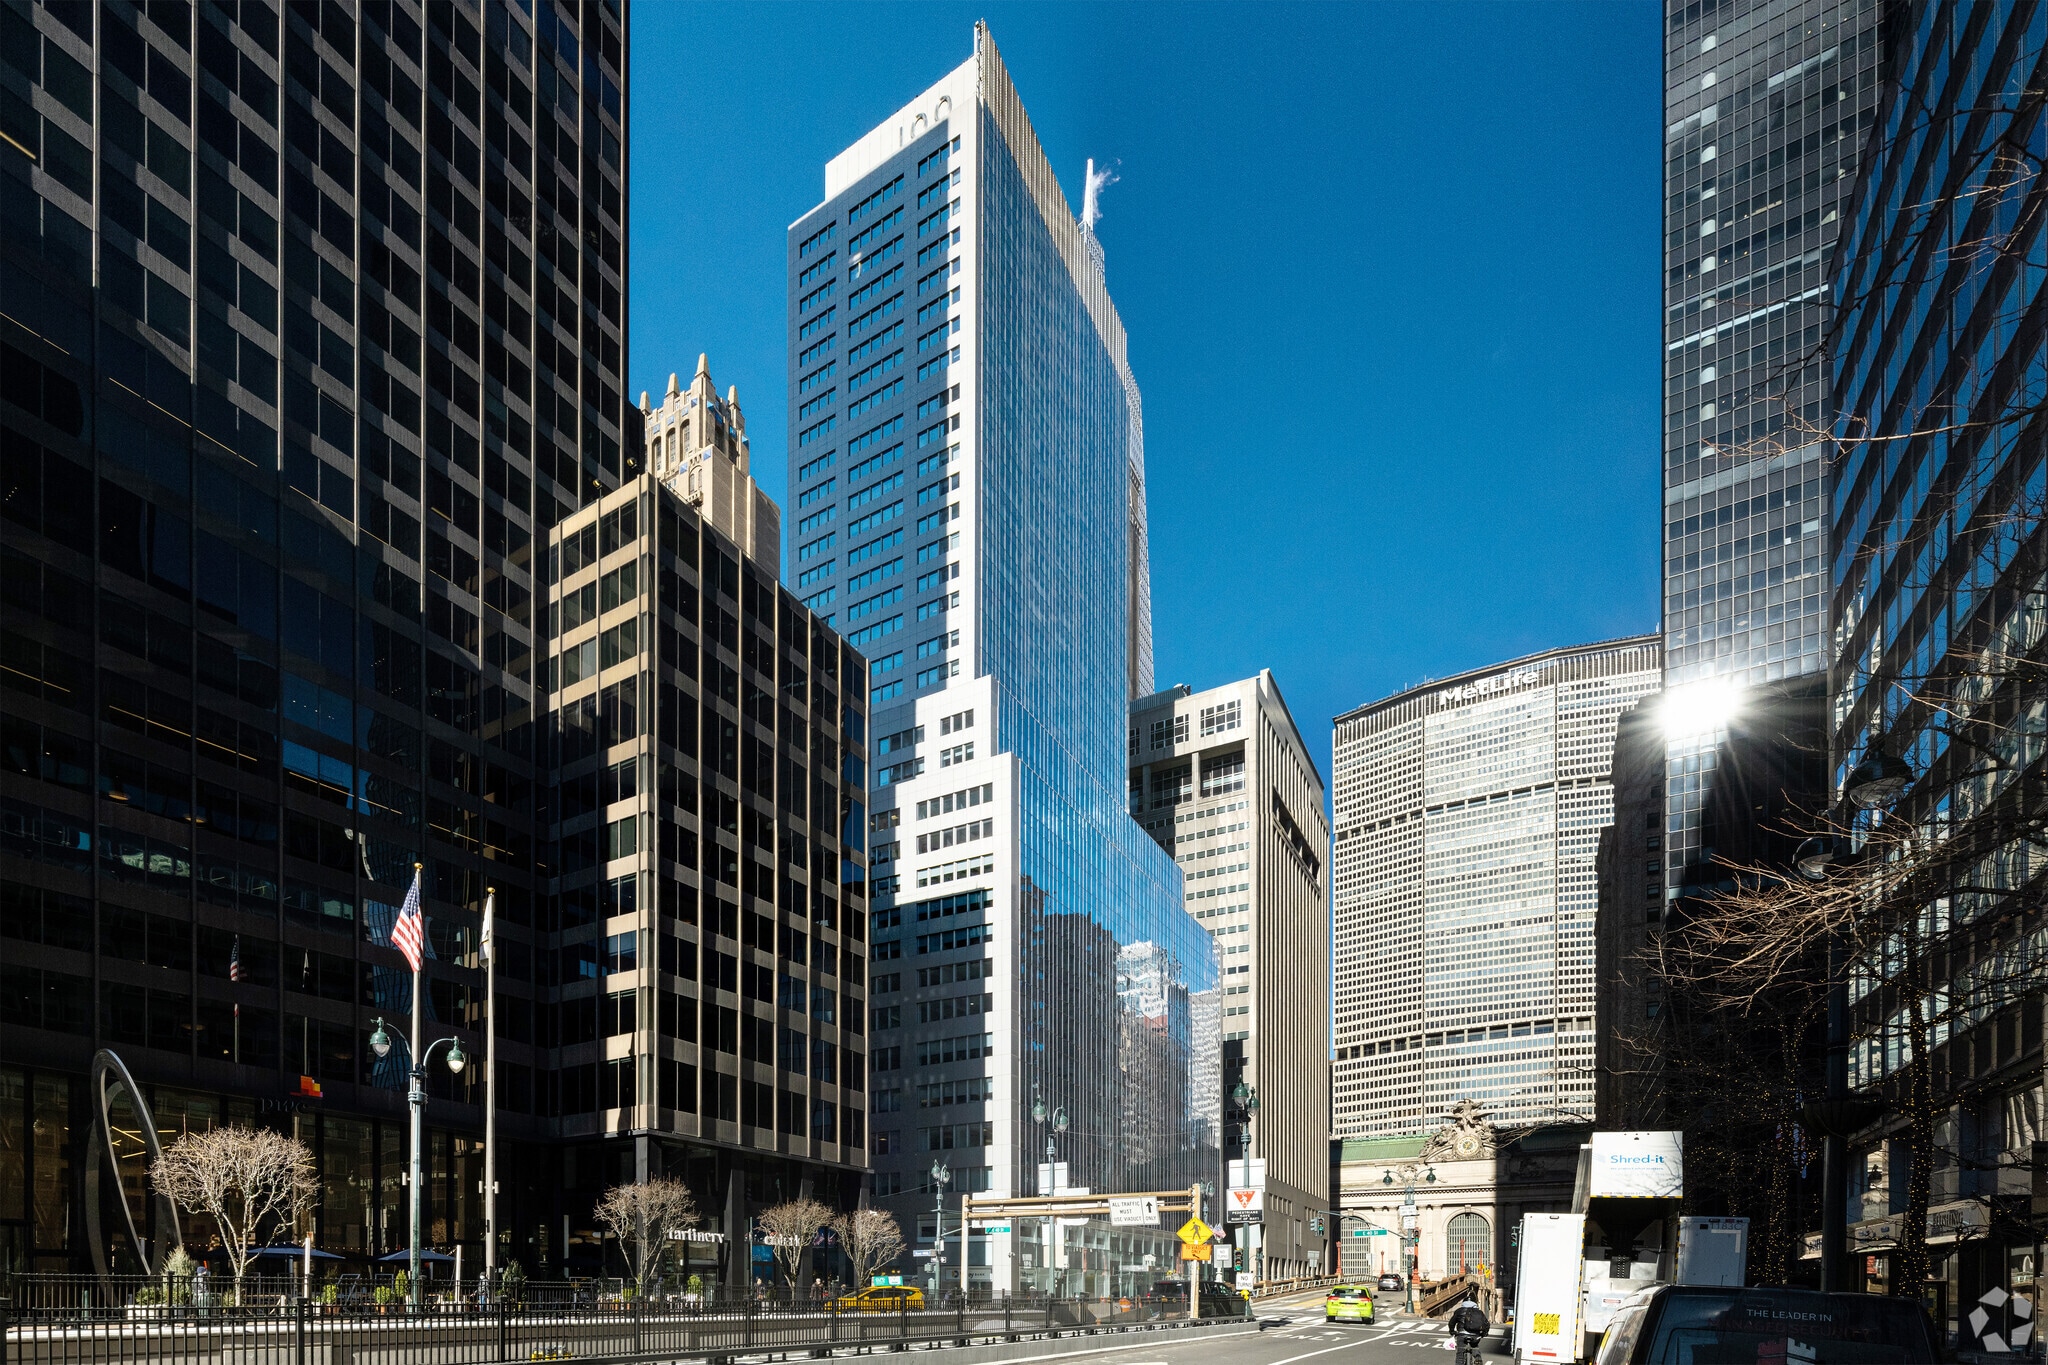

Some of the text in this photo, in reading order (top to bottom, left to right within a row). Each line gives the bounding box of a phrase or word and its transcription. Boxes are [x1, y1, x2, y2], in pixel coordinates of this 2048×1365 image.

[899, 95, 953, 147] 100
[1439, 670, 1538, 706] MetLife
[259, 1097, 307, 1114] pwc
[1610, 1154, 1665, 1164] Shred-it
[668, 1227, 725, 1244] tartinery
[1746, 1308, 1833, 1322] THE LEADER IN
[1708, 1318, 1786, 1334] MANAGED
[1272, 1334, 1350, 1342] ONLY
[1388, 1340, 1446, 1349] ONL
